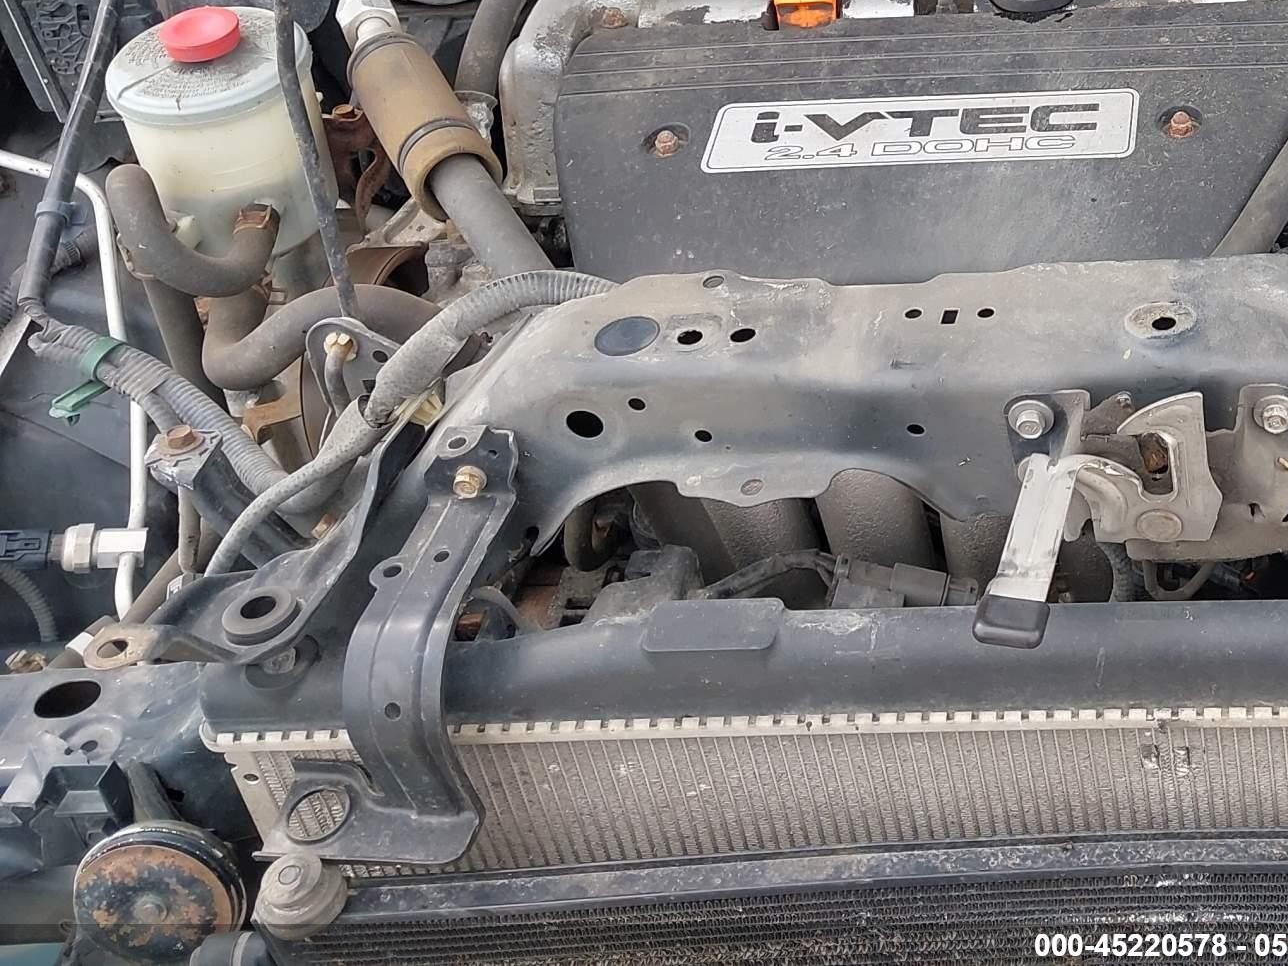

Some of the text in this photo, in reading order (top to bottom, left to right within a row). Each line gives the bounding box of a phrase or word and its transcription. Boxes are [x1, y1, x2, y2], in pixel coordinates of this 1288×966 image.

[750, 103, 1100, 143] i-VTEC
[765, 135, 1076, 161] 2.4 DOHC
